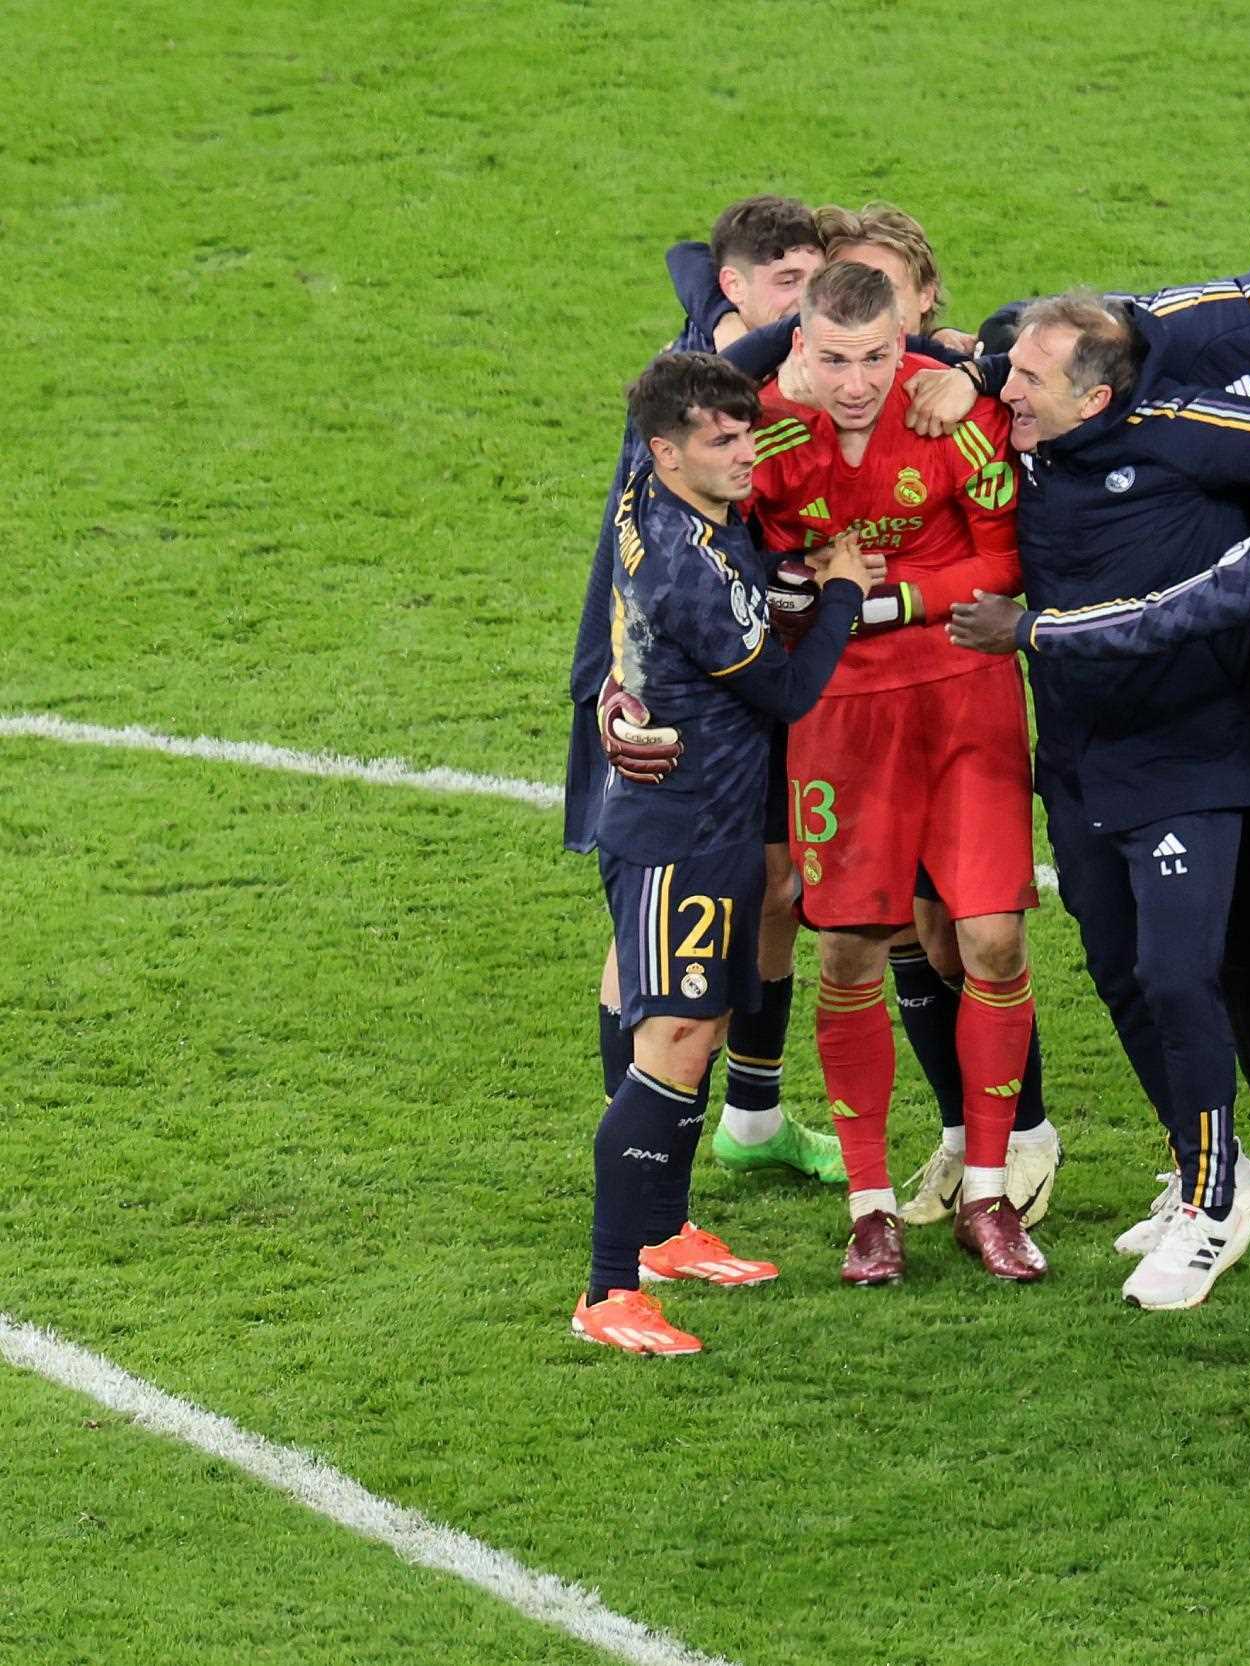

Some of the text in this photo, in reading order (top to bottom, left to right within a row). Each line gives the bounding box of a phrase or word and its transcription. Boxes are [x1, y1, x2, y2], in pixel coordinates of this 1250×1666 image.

[973, 465, 1006, 510] hp
[803, 516, 923, 549] Eates
[792, 780, 839, 843] 13
[1161, 858, 1189, 876] LL
[674, 894, 734, 960] 21
[895, 994, 936, 1008] MCF
